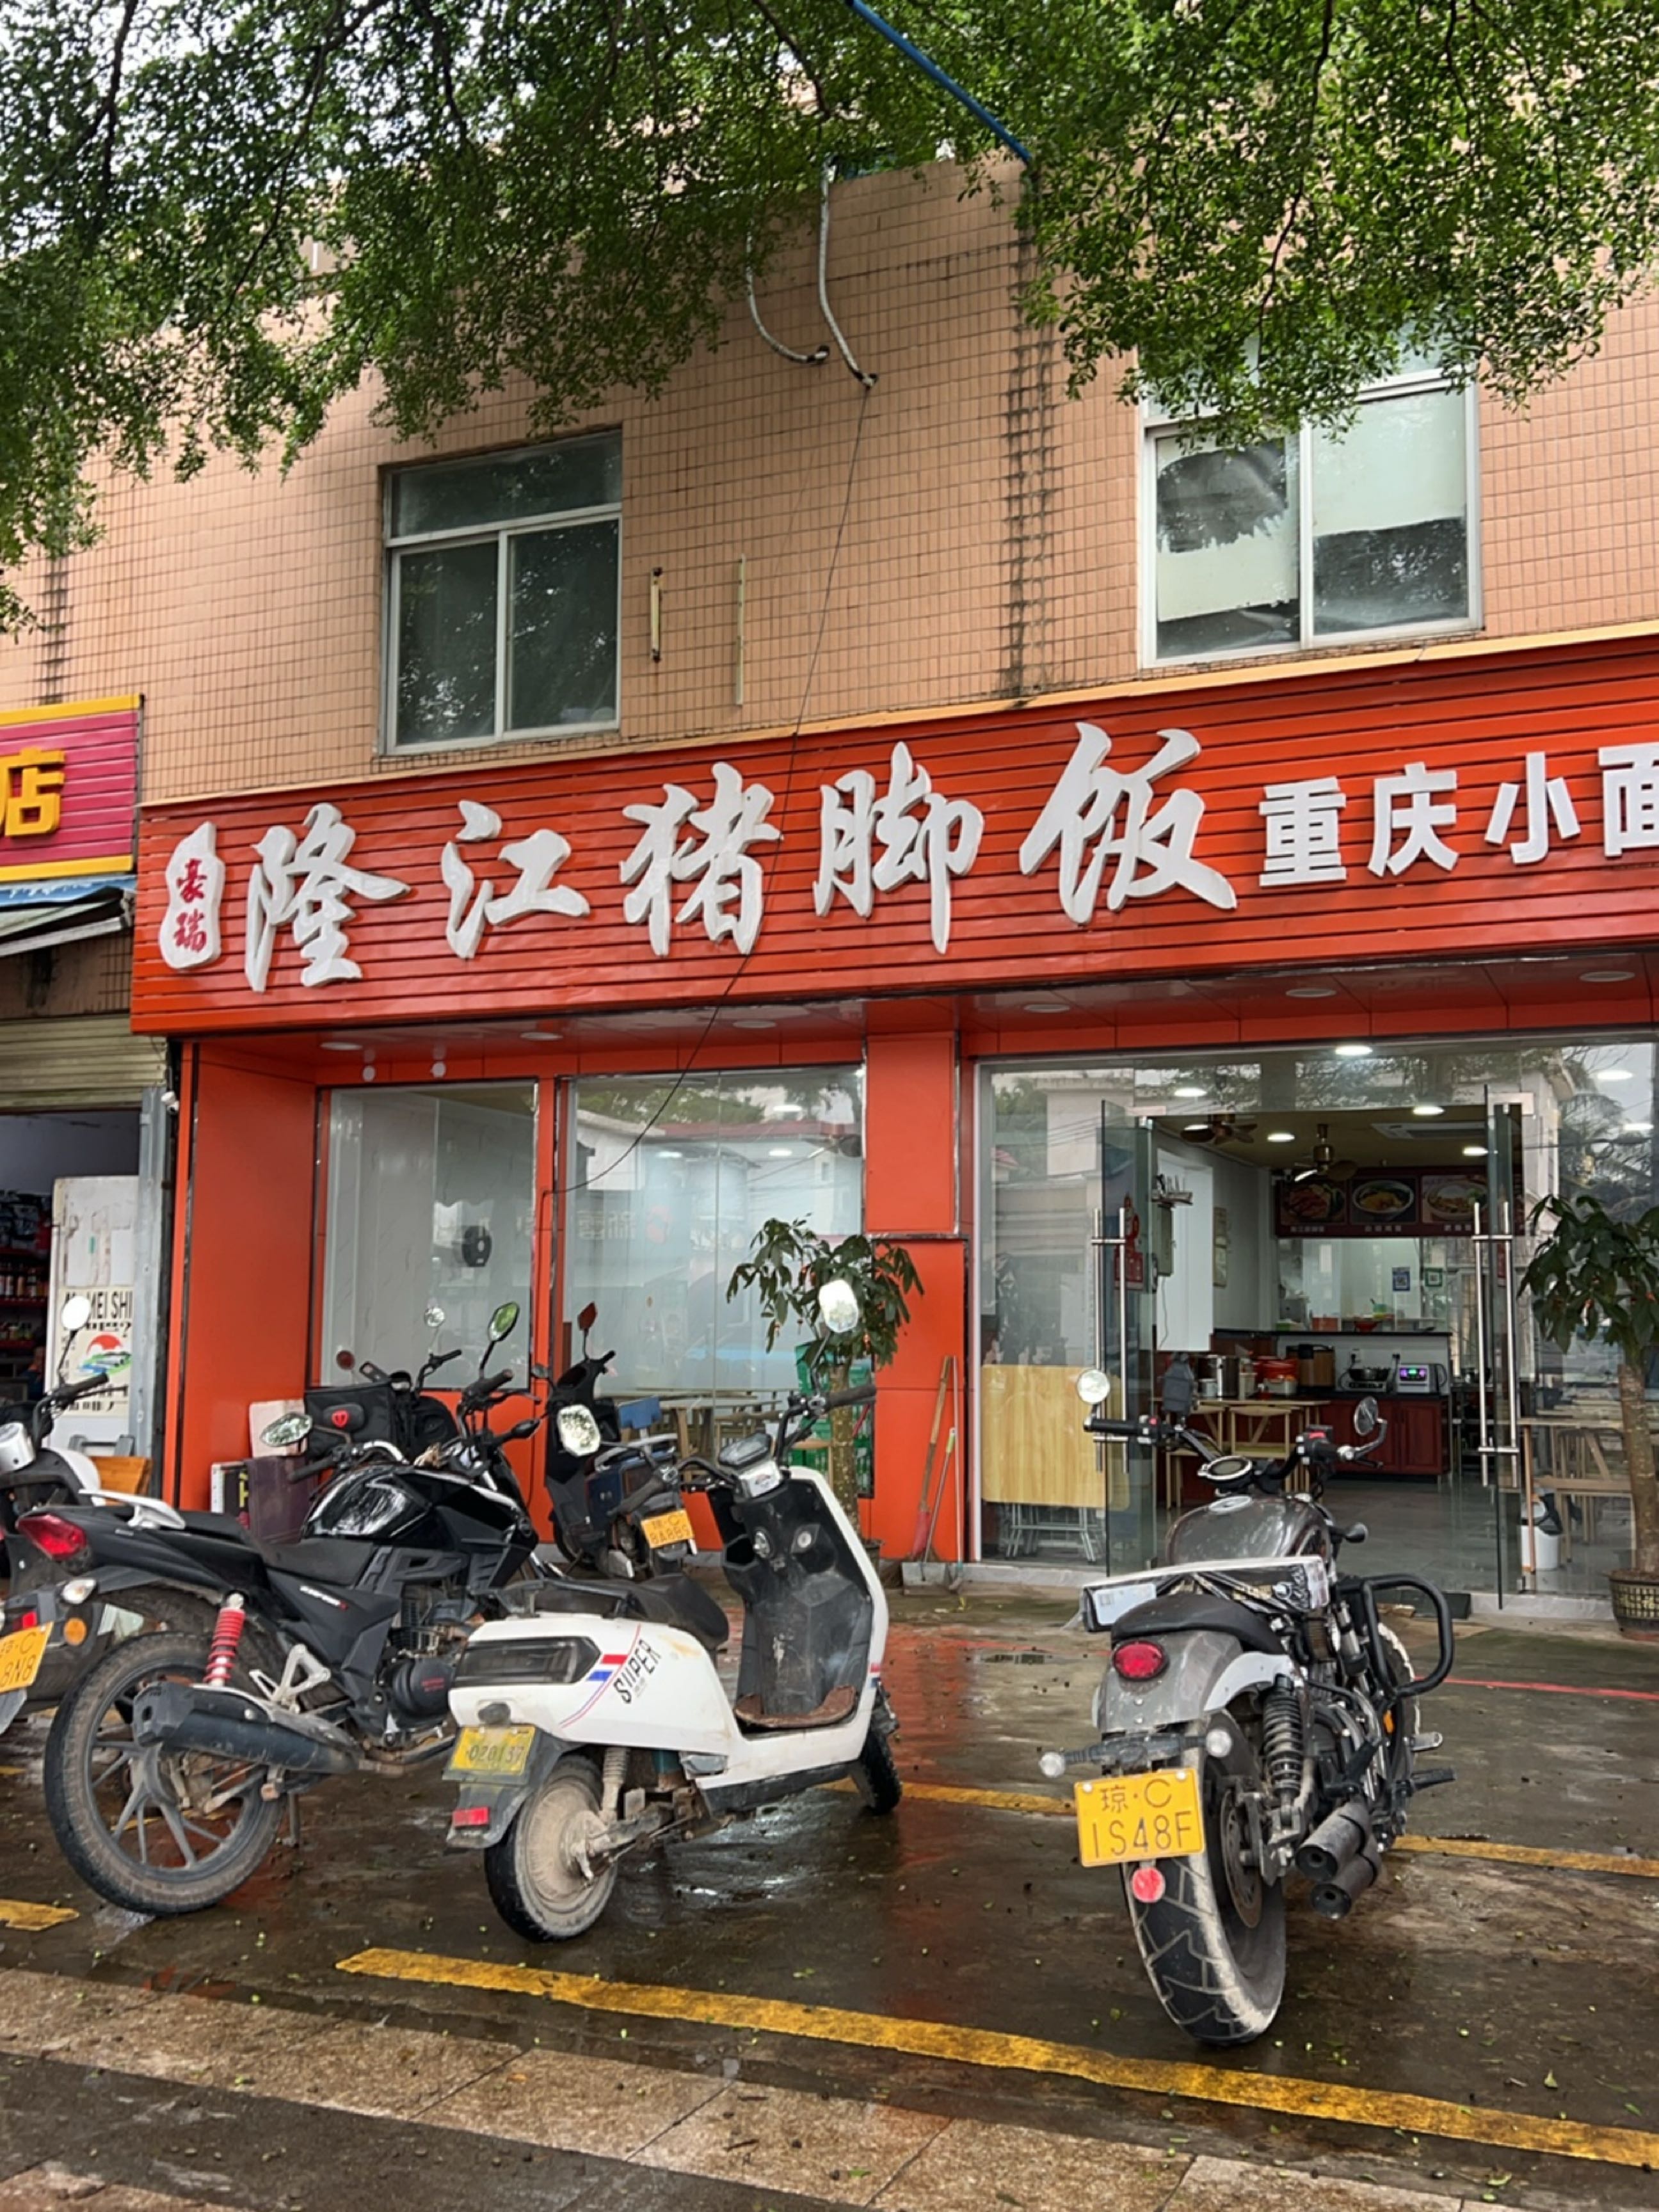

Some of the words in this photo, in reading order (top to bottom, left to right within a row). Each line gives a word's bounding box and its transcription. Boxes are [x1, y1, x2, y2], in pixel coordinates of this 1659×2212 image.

[0, 747, 67, 837] 店
[1259, 742, 1659, 887] 重庆小面
[175, 858, 207, 954] 豪瑞
[245, 722, 1238, 993] 隆江猪脚饭
